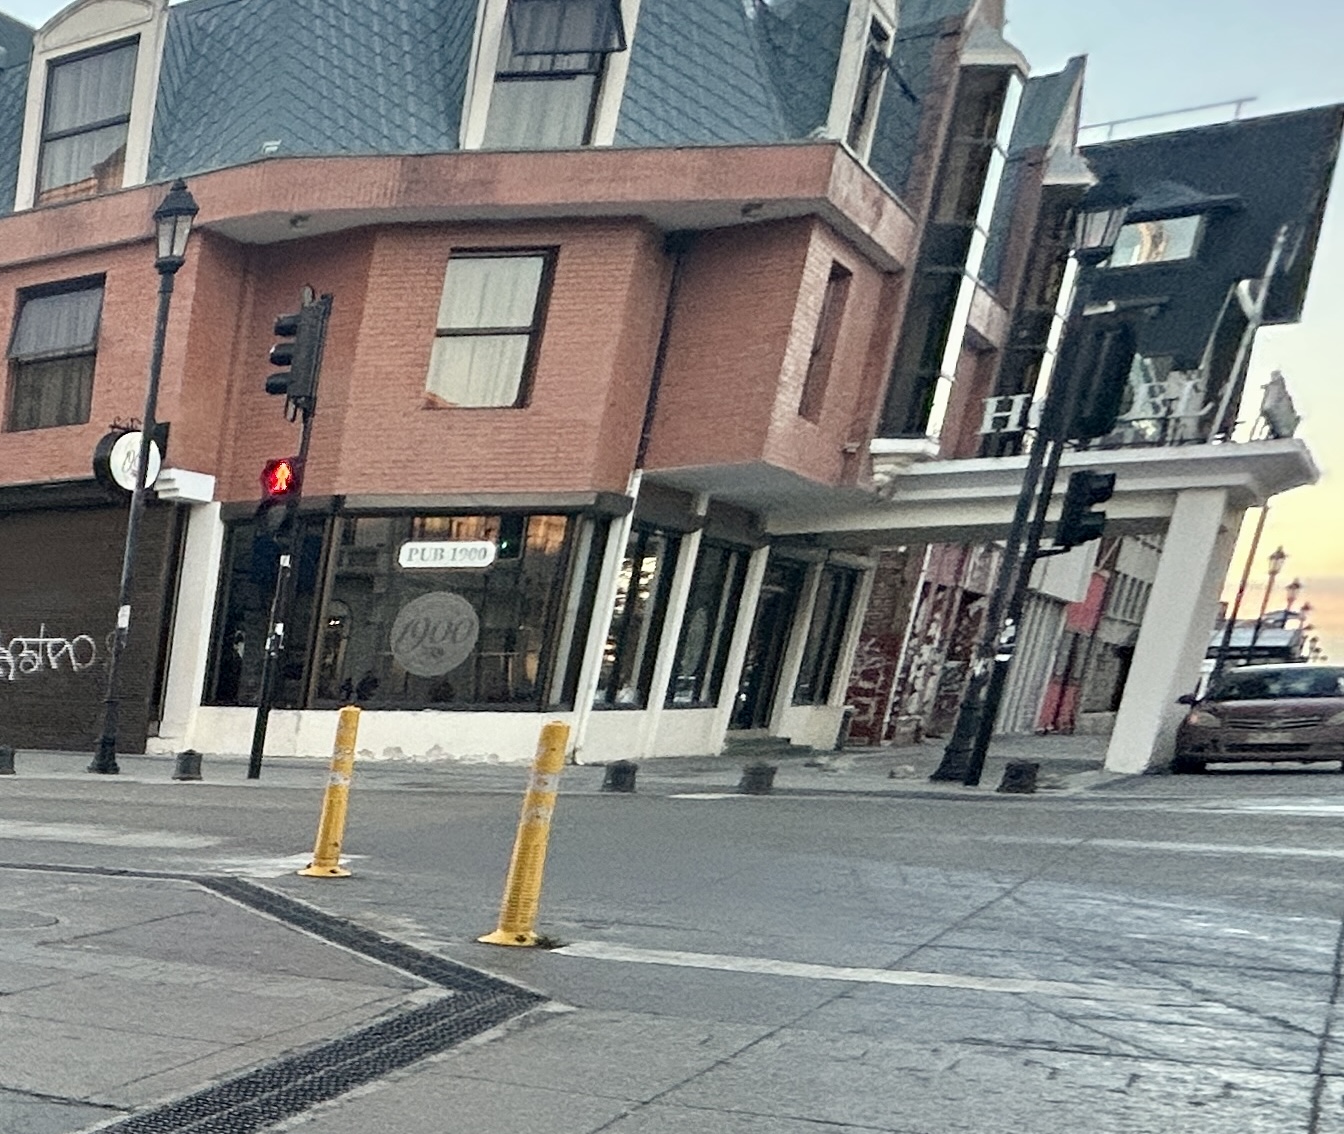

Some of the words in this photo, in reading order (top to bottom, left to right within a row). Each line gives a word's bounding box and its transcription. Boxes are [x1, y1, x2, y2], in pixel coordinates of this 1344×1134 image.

[978, 381, 1215, 434] HEL
[406, 547, 445, 562] PUB
[451, 547, 488, 561] 1900
